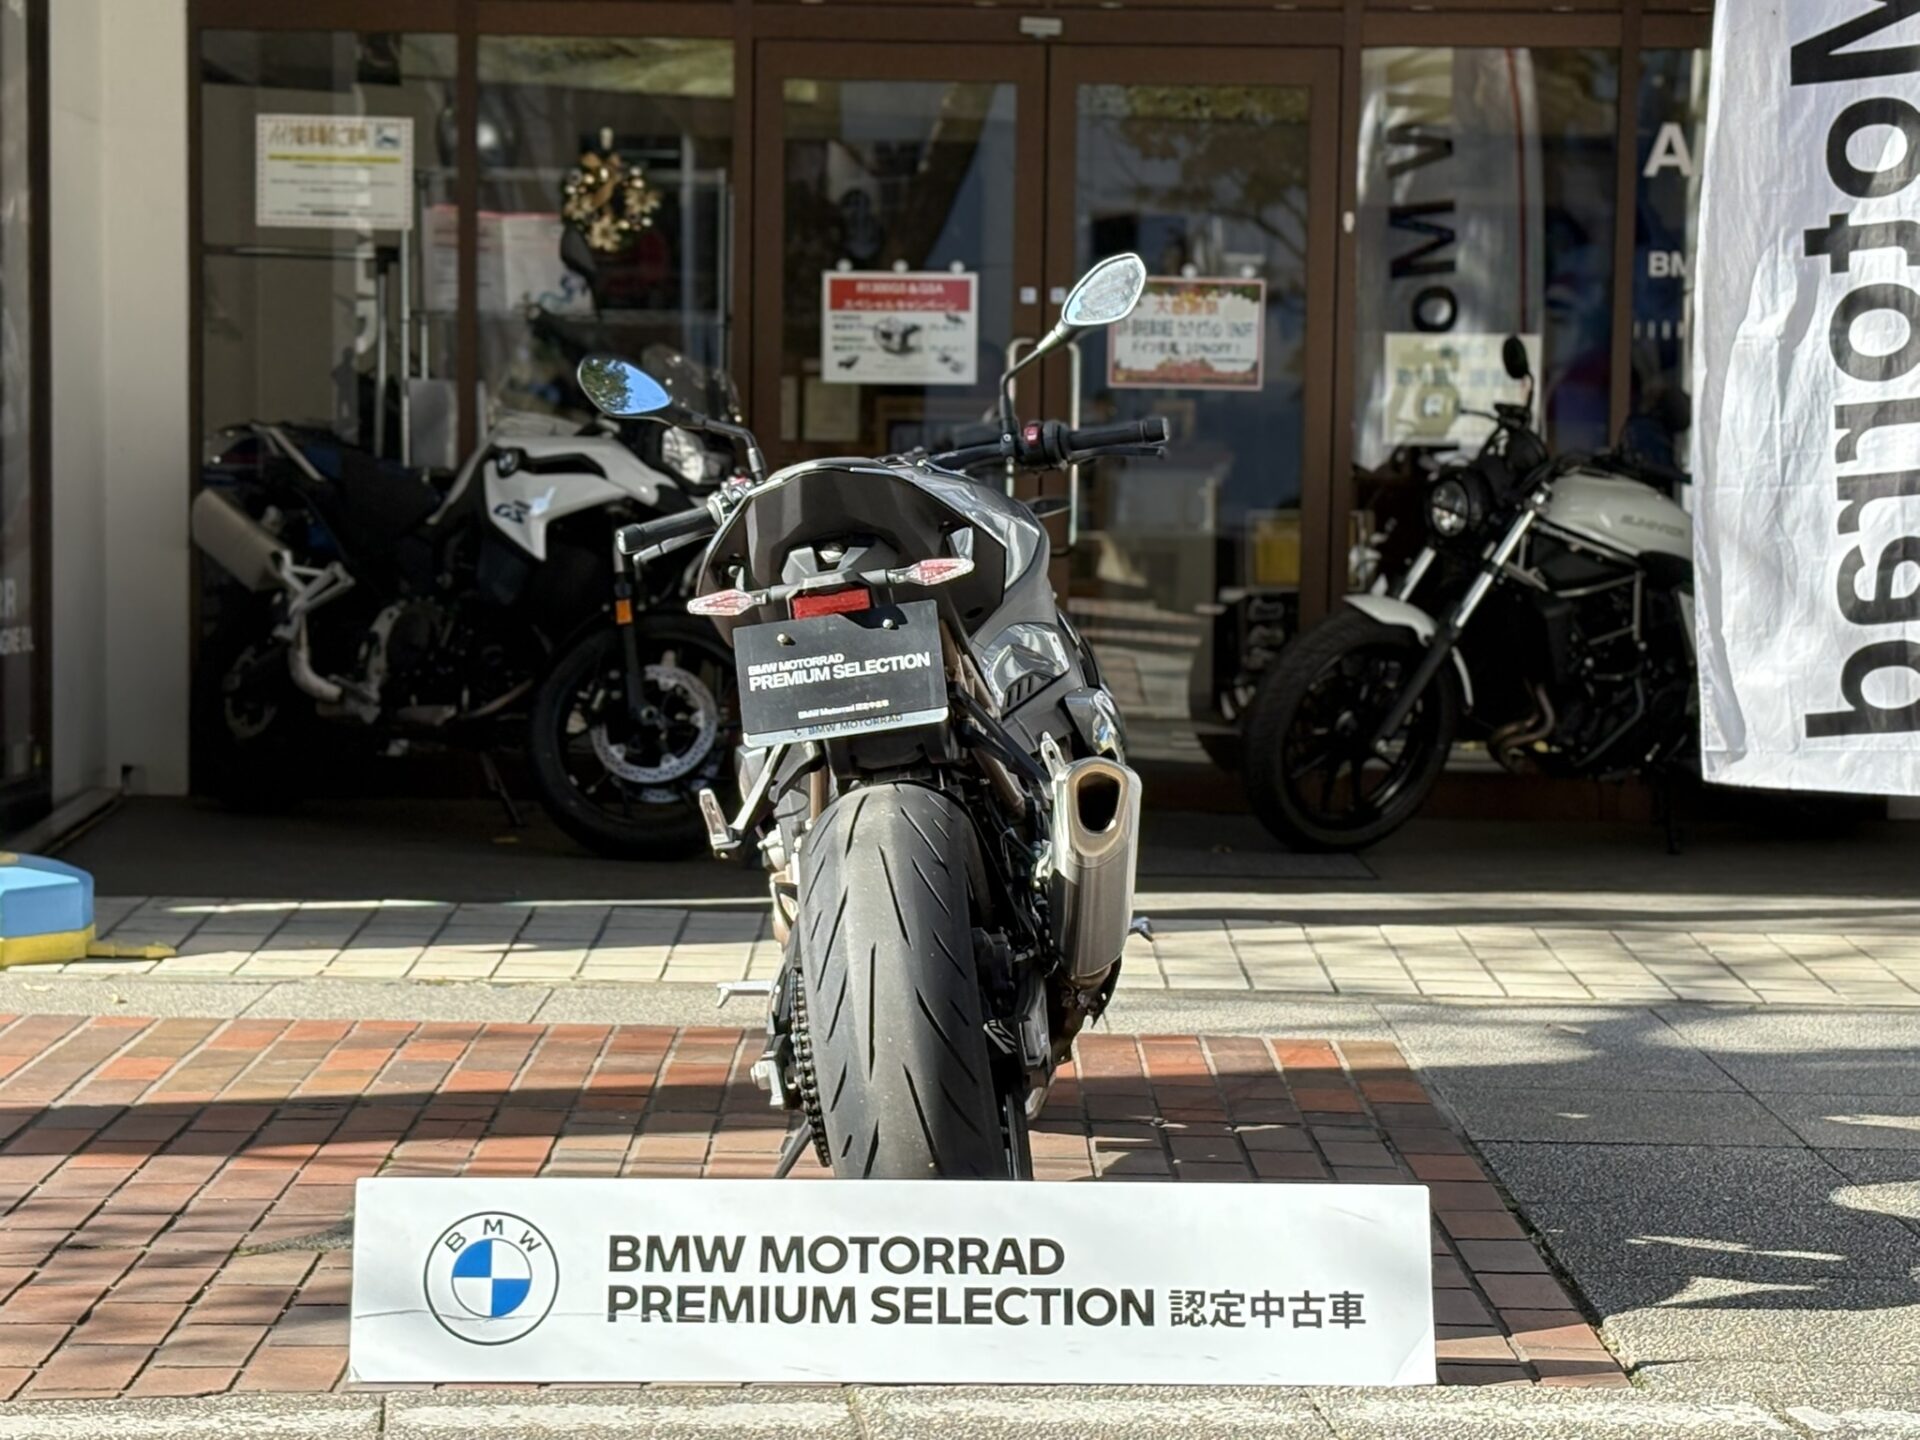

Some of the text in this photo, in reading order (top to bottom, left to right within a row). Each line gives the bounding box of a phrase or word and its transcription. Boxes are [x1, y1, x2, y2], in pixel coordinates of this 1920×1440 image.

[748, 653, 845, 676] BMW MOTORRAD
[749, 651, 931, 692] PREMIUM SELECTION
[445, 1217, 543, 1254] BMW
[608, 1235, 1066, 1275] BMW MOTORRAD
[607, 1285, 1368, 1330] PREMIUM SELECTION 認定中古車
